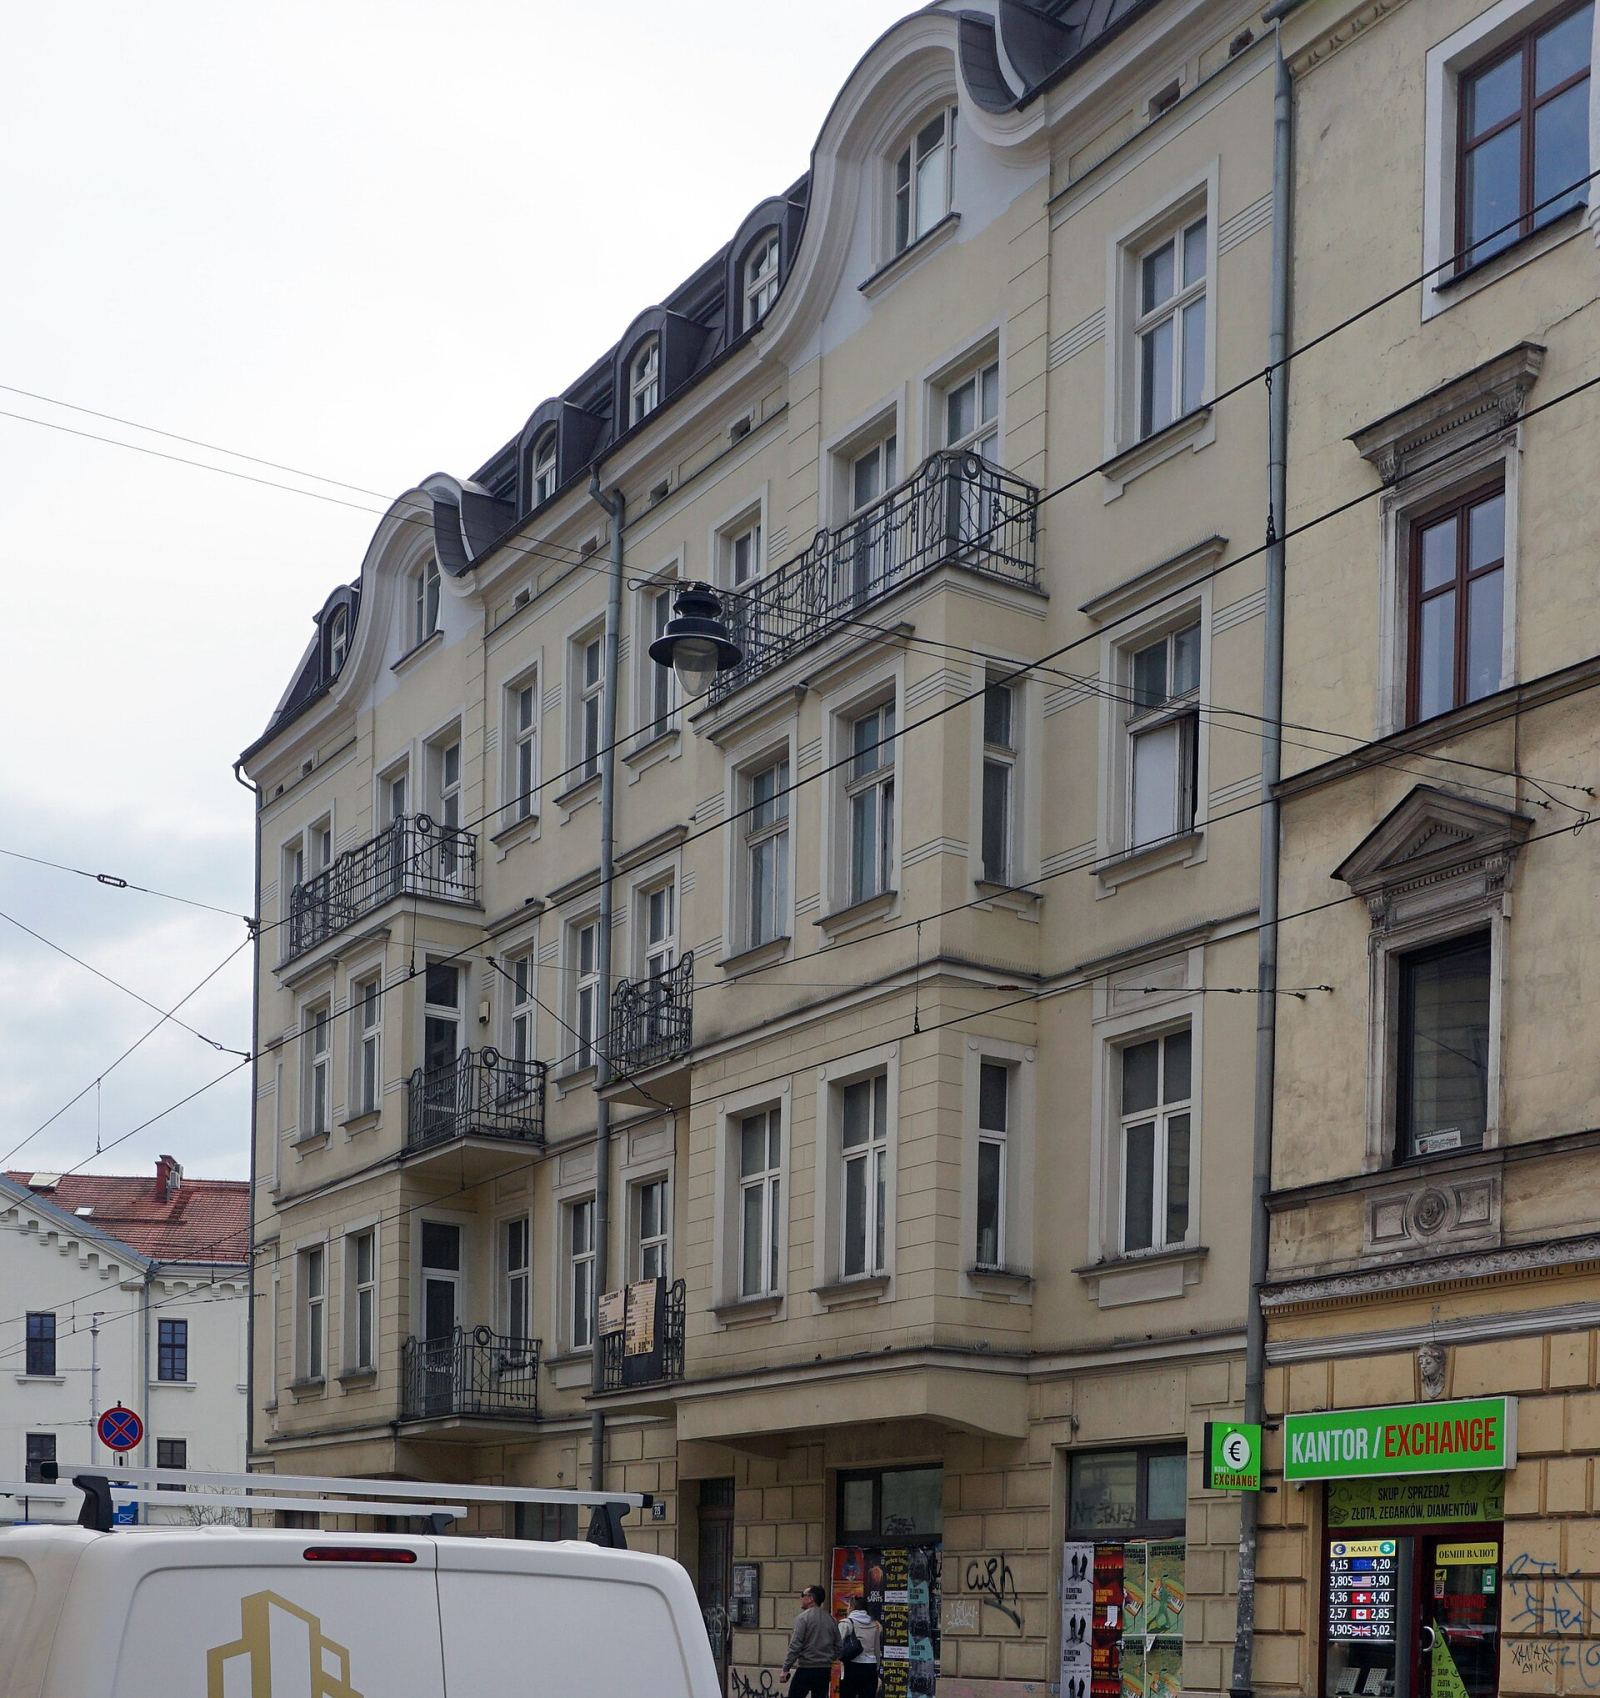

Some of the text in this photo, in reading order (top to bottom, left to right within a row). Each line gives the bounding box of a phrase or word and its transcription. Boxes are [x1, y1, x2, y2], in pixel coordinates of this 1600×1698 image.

[1292, 1428, 1368, 1464] KANTOR
[1385, 1417, 1497, 1458] EXCHANGE
[1213, 1472, 1258, 1488] EXCHANGE
[1378, 1486, 1399, 1500] SKUP
[1408, 1482, 1450, 1499] SPRZEDAŻ
[1351, 1500, 1478, 1520] ZŁOTA, ZEGARKÓW, DIAMENTÓW
[1350, 1545, 1378, 1553] KARAT
[1330, 1559, 1390, 1572] 4,15 4,20
[1330, 1575, 1390, 1588] 3,805 3,90
[1330, 1591, 1390, 1604] 4,36 4,40
[1329, 1608, 1390, 1620] 2,57 2,85
[1329, 1624, 1390, 1637] 4,905 5,02
